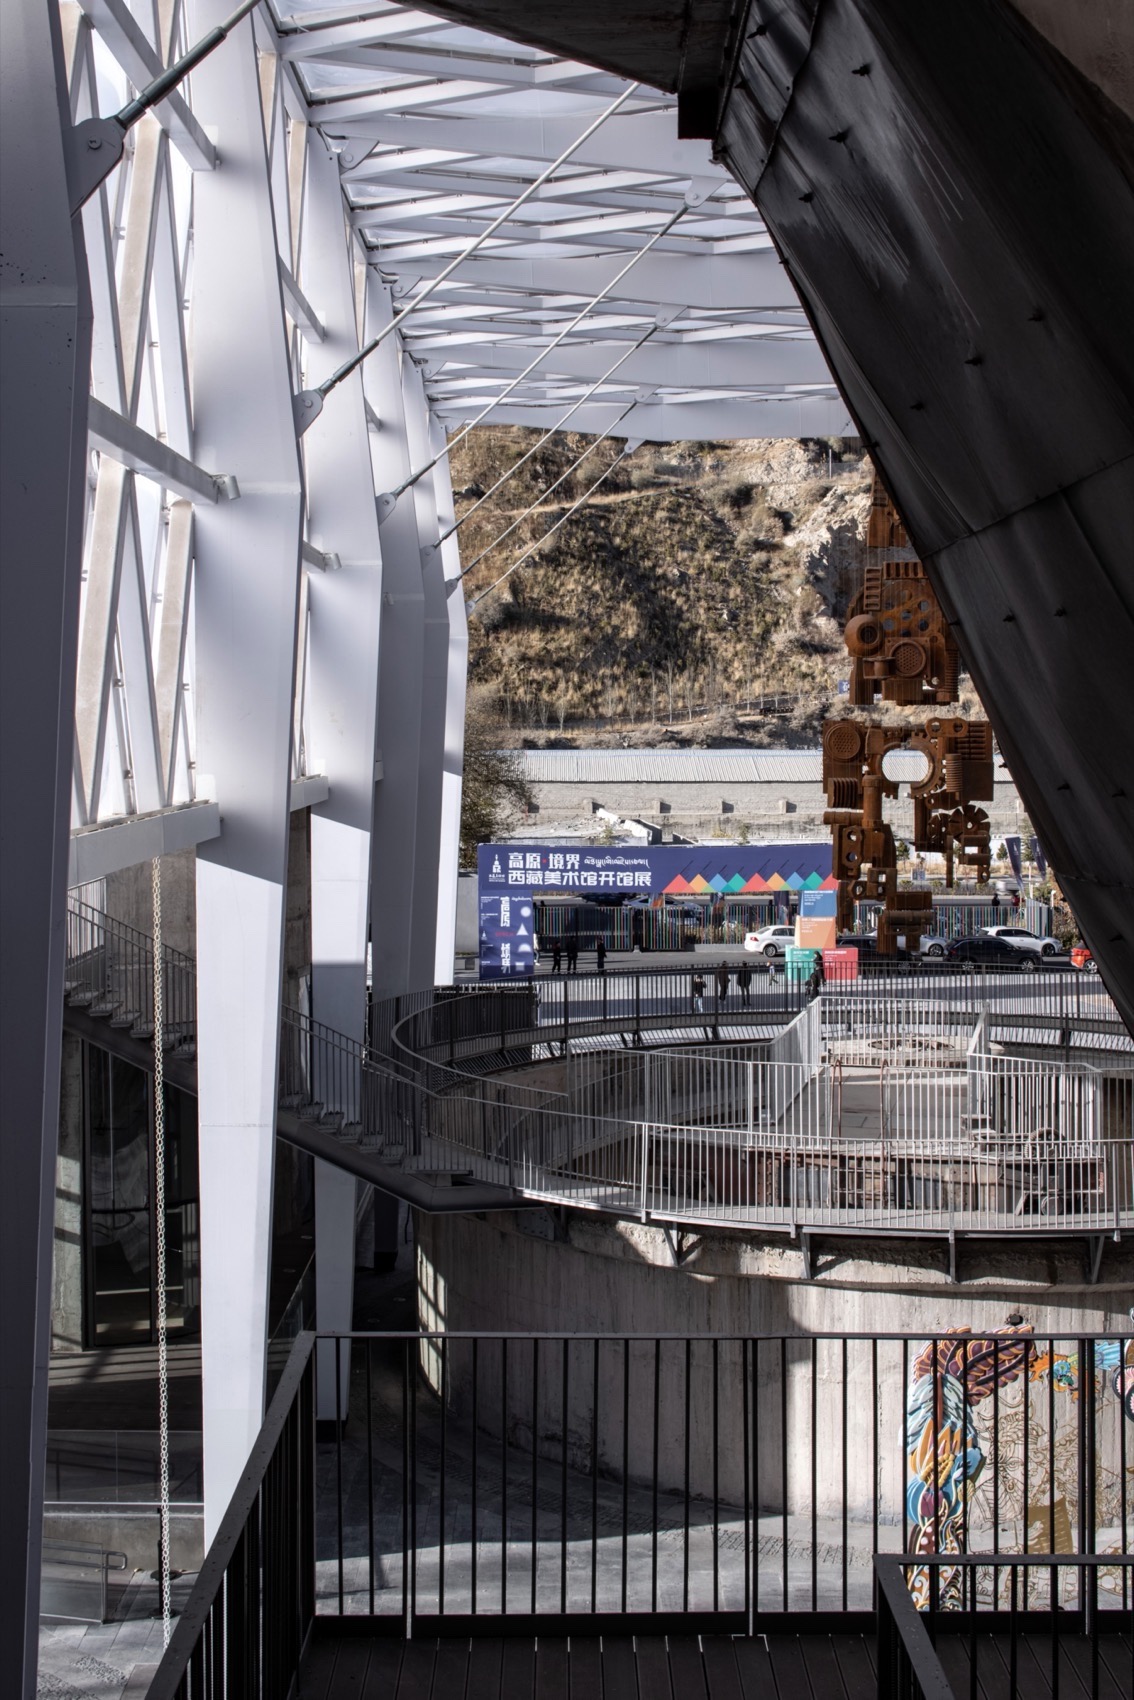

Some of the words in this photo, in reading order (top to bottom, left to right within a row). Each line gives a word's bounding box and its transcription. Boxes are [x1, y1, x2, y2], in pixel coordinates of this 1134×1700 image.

[508, 870, 652, 887] 西藏美术馆开馆展
